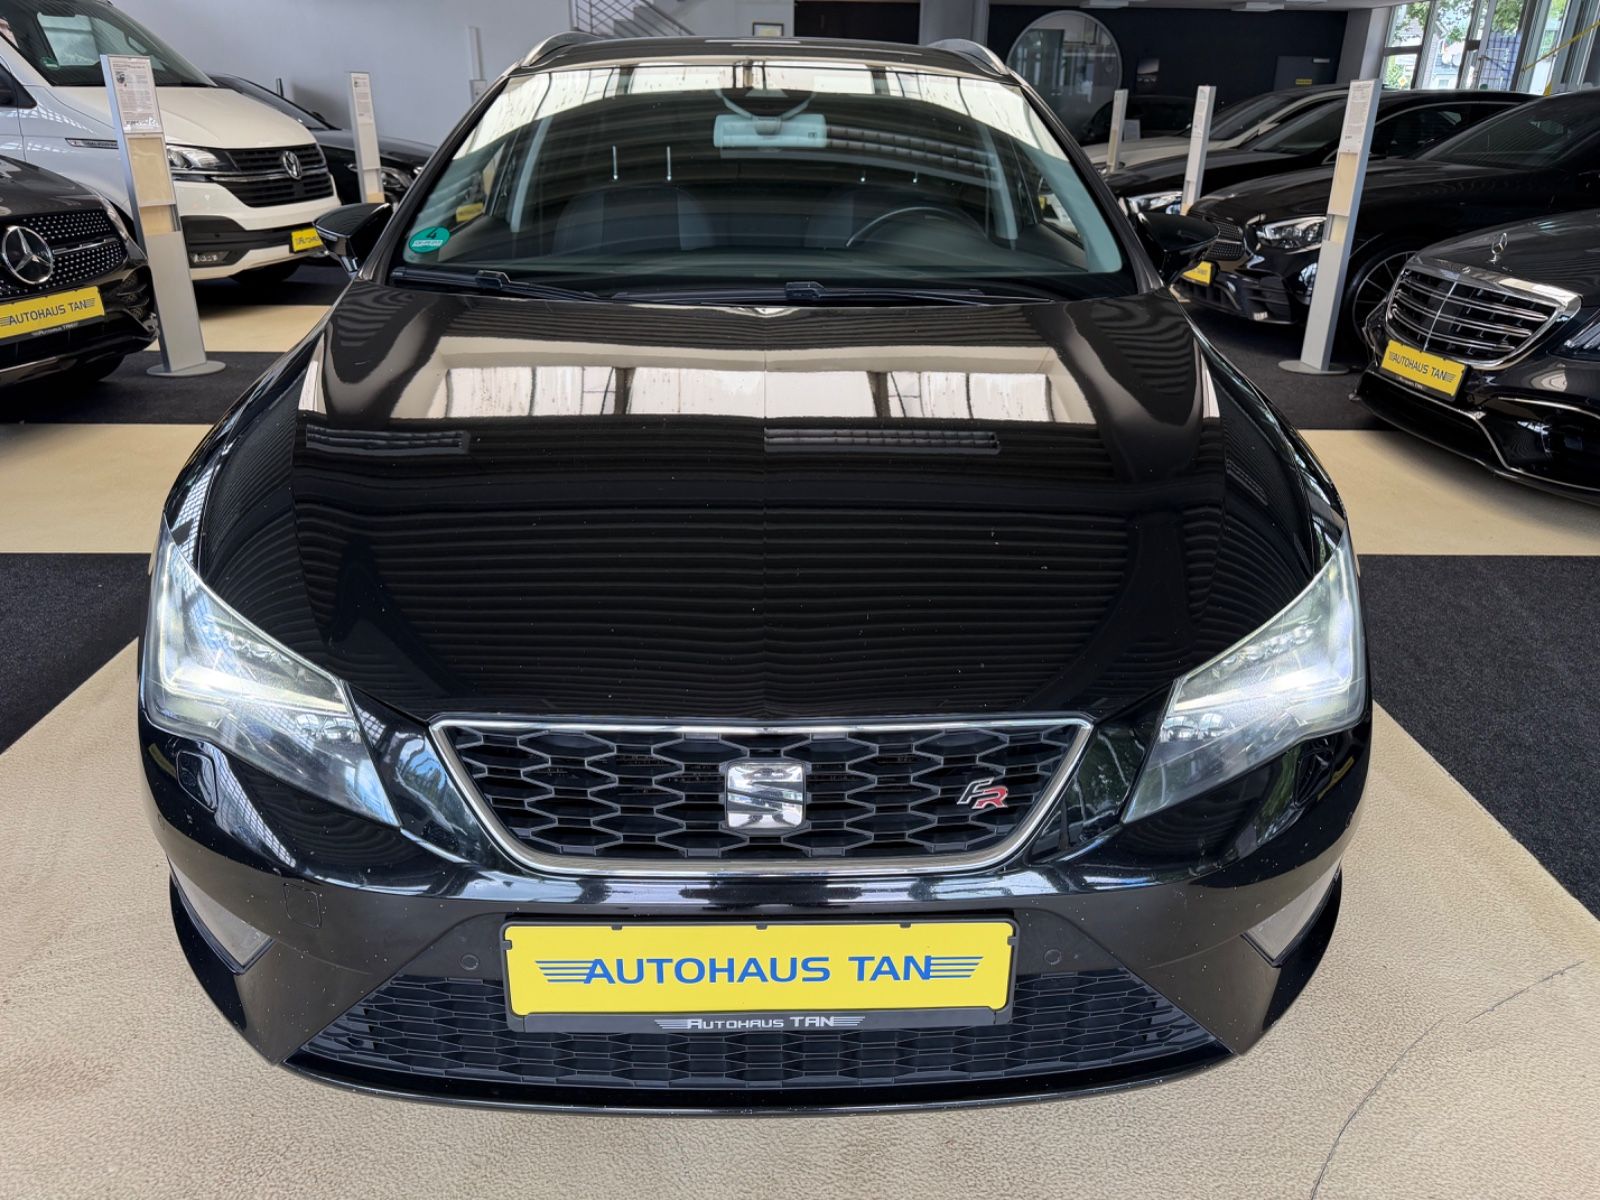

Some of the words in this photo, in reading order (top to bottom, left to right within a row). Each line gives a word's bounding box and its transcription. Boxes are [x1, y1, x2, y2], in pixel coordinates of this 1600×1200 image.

[426, 227, 438, 239] 4
[9, 304, 66, 326] AUTOHAUS
[68, 299, 87, 312] TAN
[1393, 353, 1429, 374] AUTOHAUS
[1431, 366, 1447, 381] TAN
[957, 777, 1008, 809] FR
[584, 957, 831, 984] AUTOHAUS
[848, 955, 932, 982] TAN
[687, 1018, 784, 1030] AUTOHAUS
[789, 1016, 835, 1028] TAN
